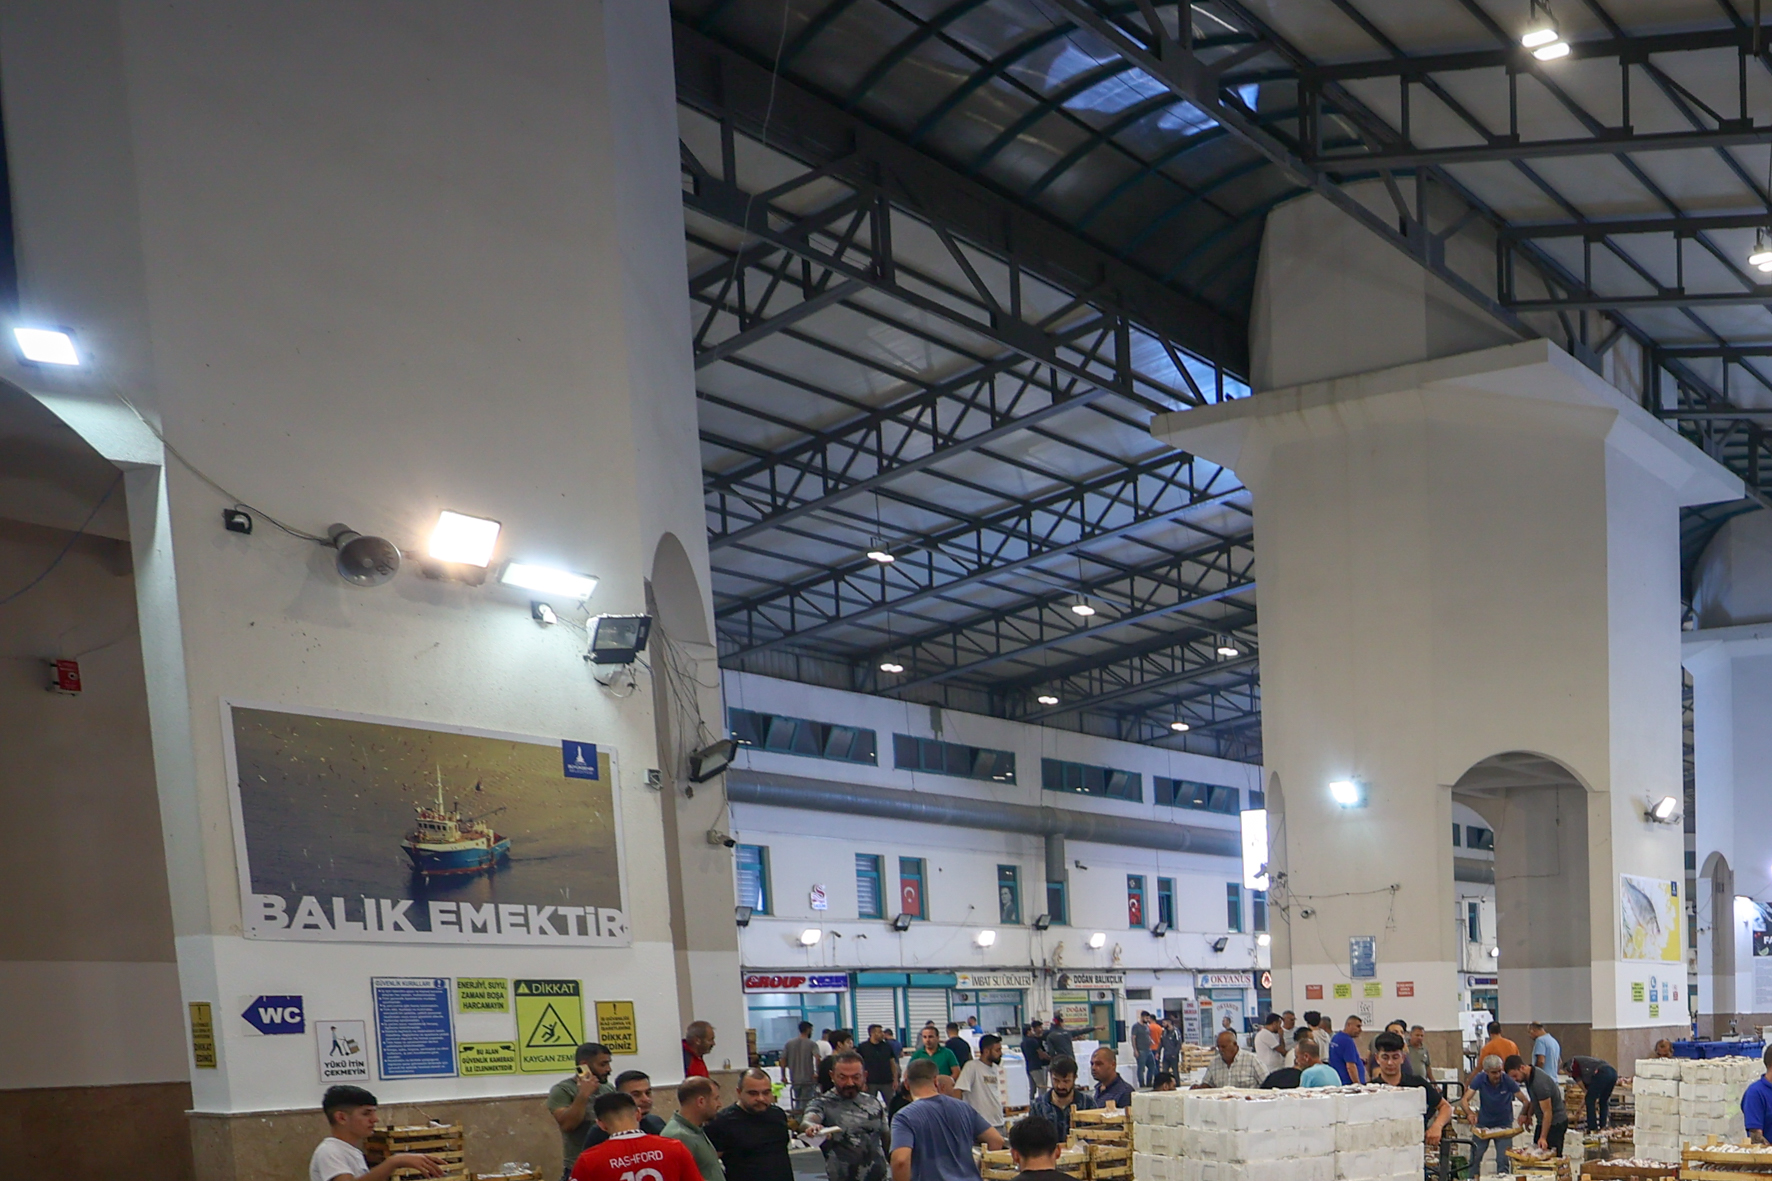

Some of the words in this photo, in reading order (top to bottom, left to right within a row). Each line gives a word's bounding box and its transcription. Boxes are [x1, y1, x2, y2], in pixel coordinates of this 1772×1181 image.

[252, 893, 419, 932] BALIK
[428, 900, 628, 938] EMEKTİR
[746, 976, 806, 988] GROUP
[1073, 974, 1093, 984] DOĞAN
[1095, 975, 1123, 984] BALIKÇILIK
[1211, 975, 1251, 983] OKYANUS
[532, 982, 575, 994] DİKKAT
[258, 1007, 301, 1024] WC
[601, 1032, 632, 1041] DİKKAT
[324, 1060, 346, 1068] YÜKÜ
[348, 1060, 365, 1068] İTİN
[523, 1055, 556, 1063] KAYGAN
[324, 1068, 366, 1077] ÇEKMEYİN
[609, 1150, 664, 1169] RASHFORD
